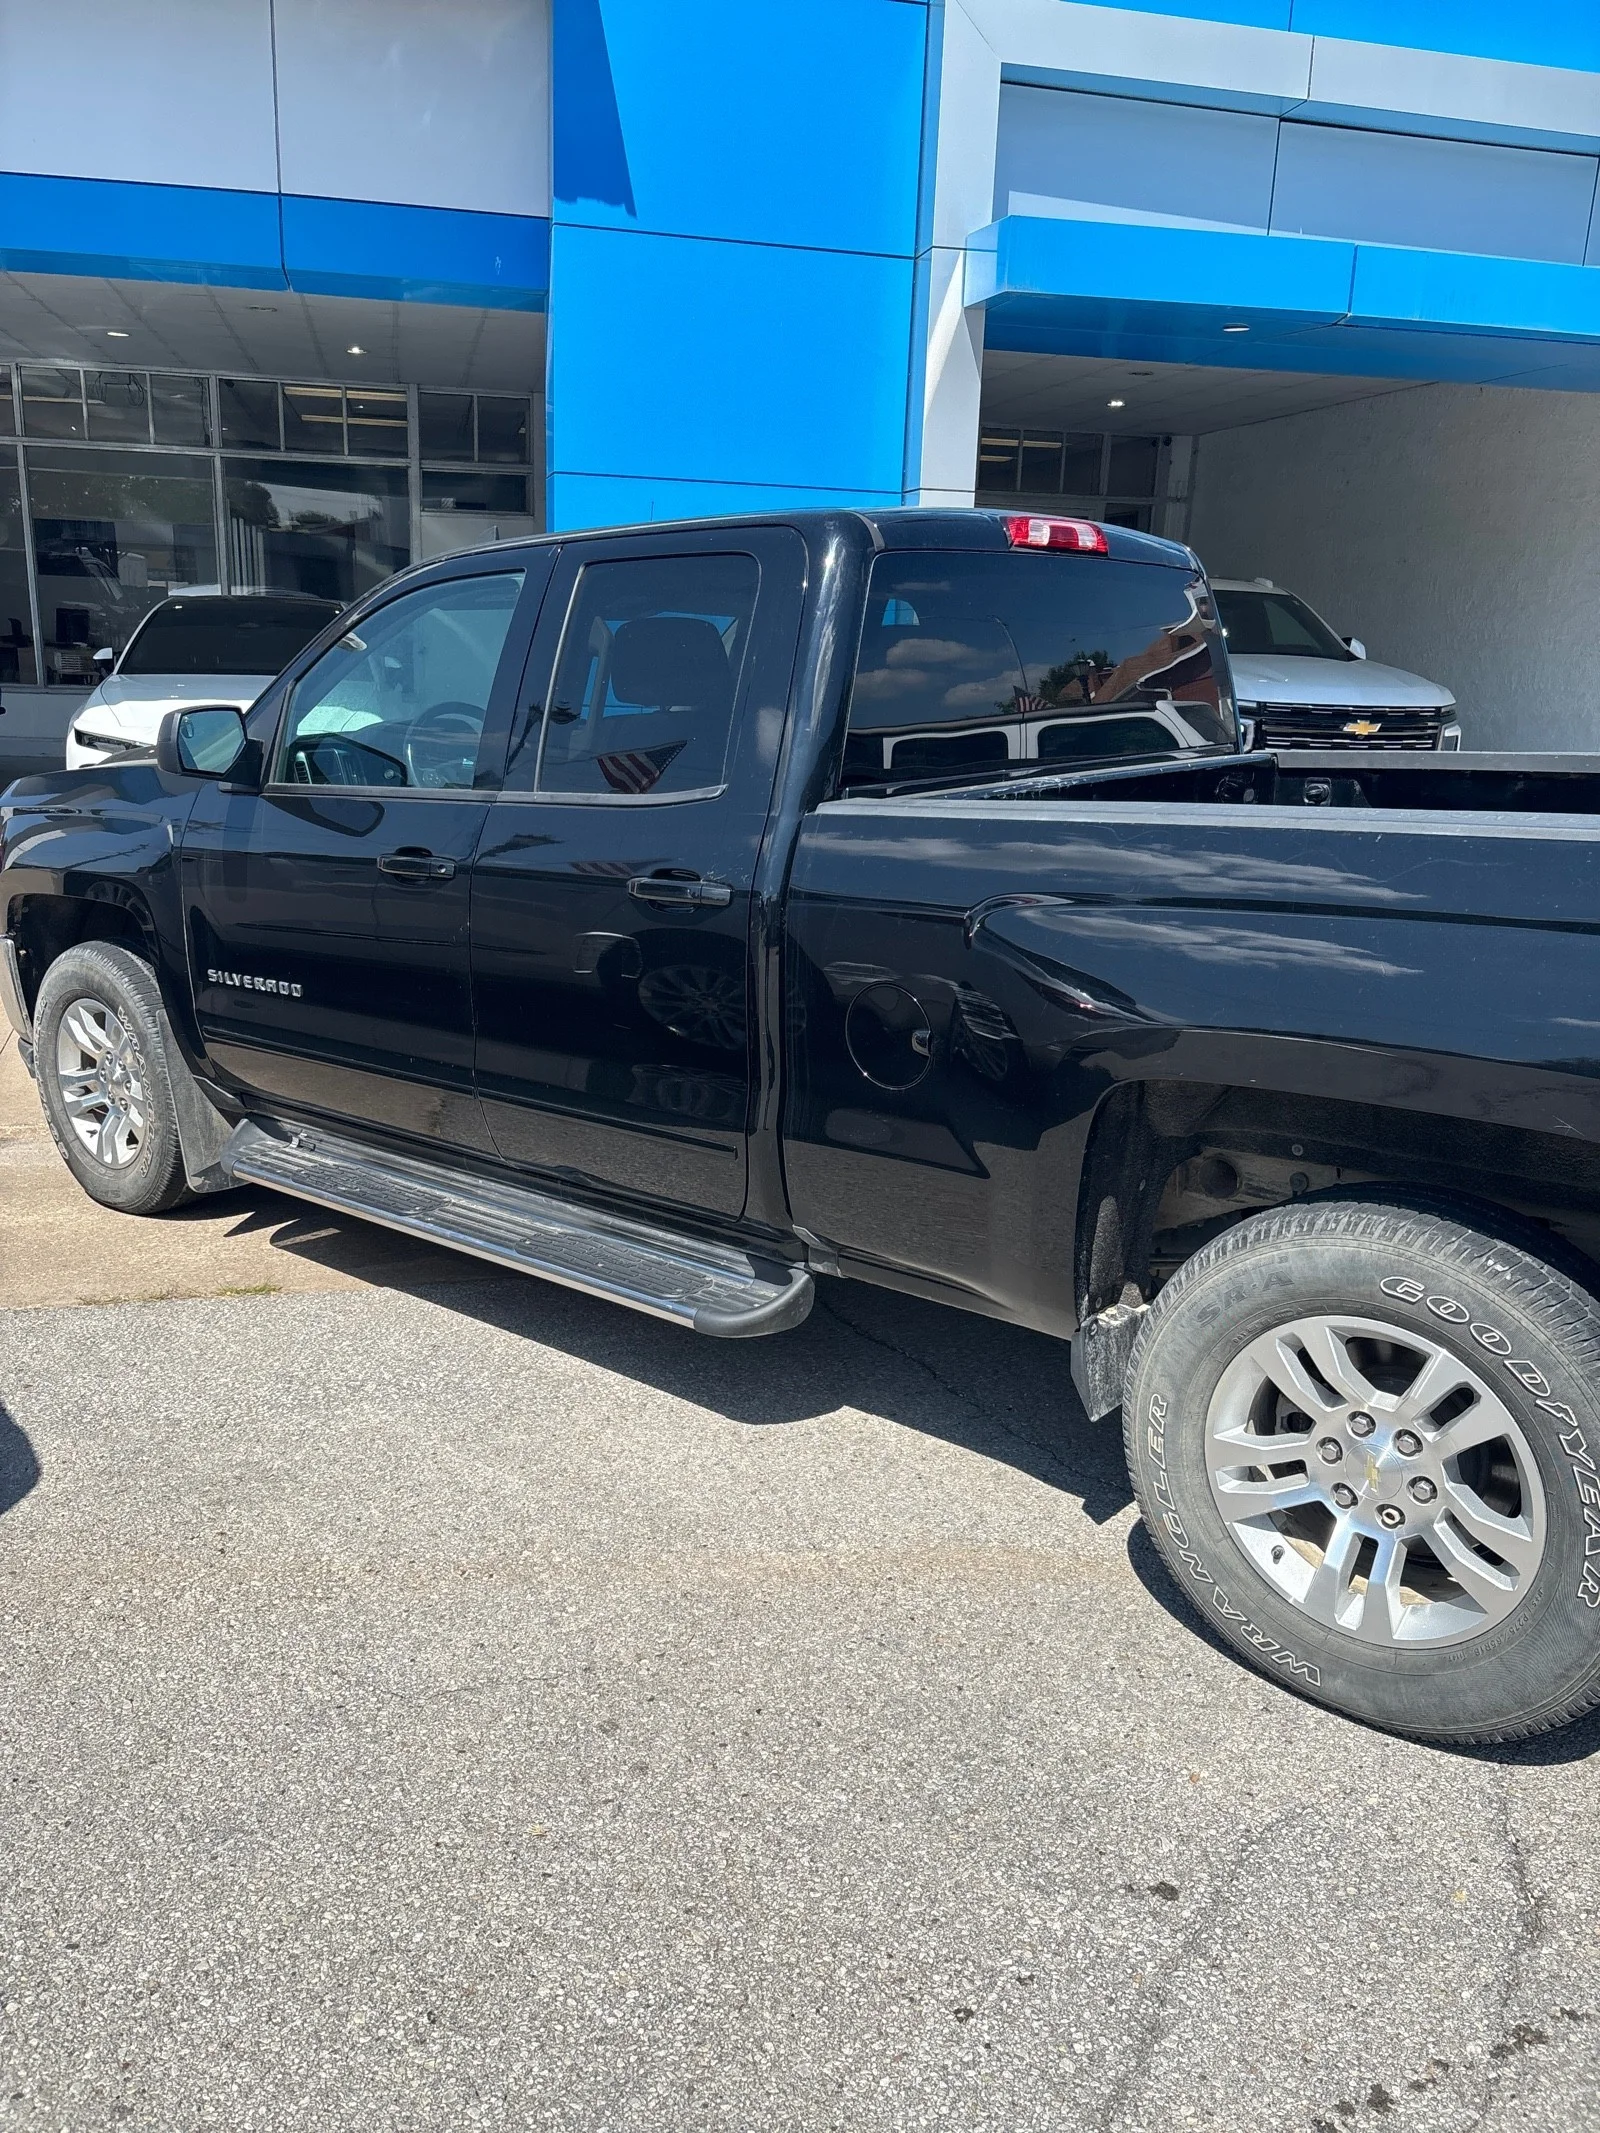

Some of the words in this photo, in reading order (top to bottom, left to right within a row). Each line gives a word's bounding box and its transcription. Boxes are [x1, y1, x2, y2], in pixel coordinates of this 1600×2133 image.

[117, 1006, 154, 1178] WRANGLER
[207, 969, 303, 997] SILVERADO
[1148, 1393, 1322, 1687] WRANGLER
[1379, 1276, 1600, 1609] GOODYEAR
